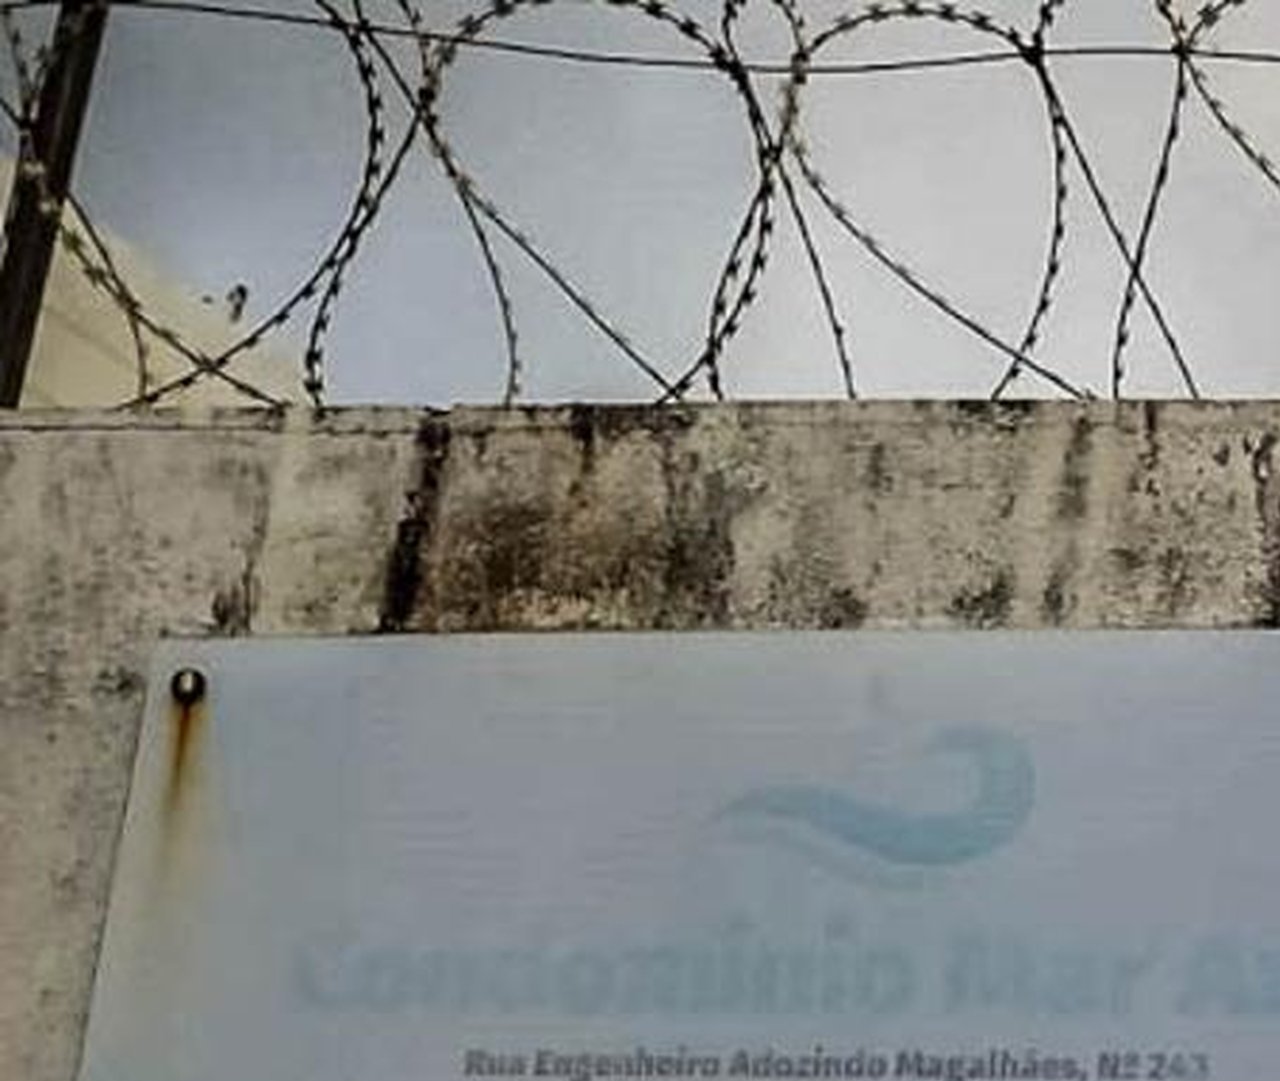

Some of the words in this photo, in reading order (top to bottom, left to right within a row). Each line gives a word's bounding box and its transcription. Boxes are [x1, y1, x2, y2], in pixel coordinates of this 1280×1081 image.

[944, 924, 1144, 1012] Mar
[464, 1050, 526, 1076] Rua
[728, 1046, 888, 1078] Adozindo
